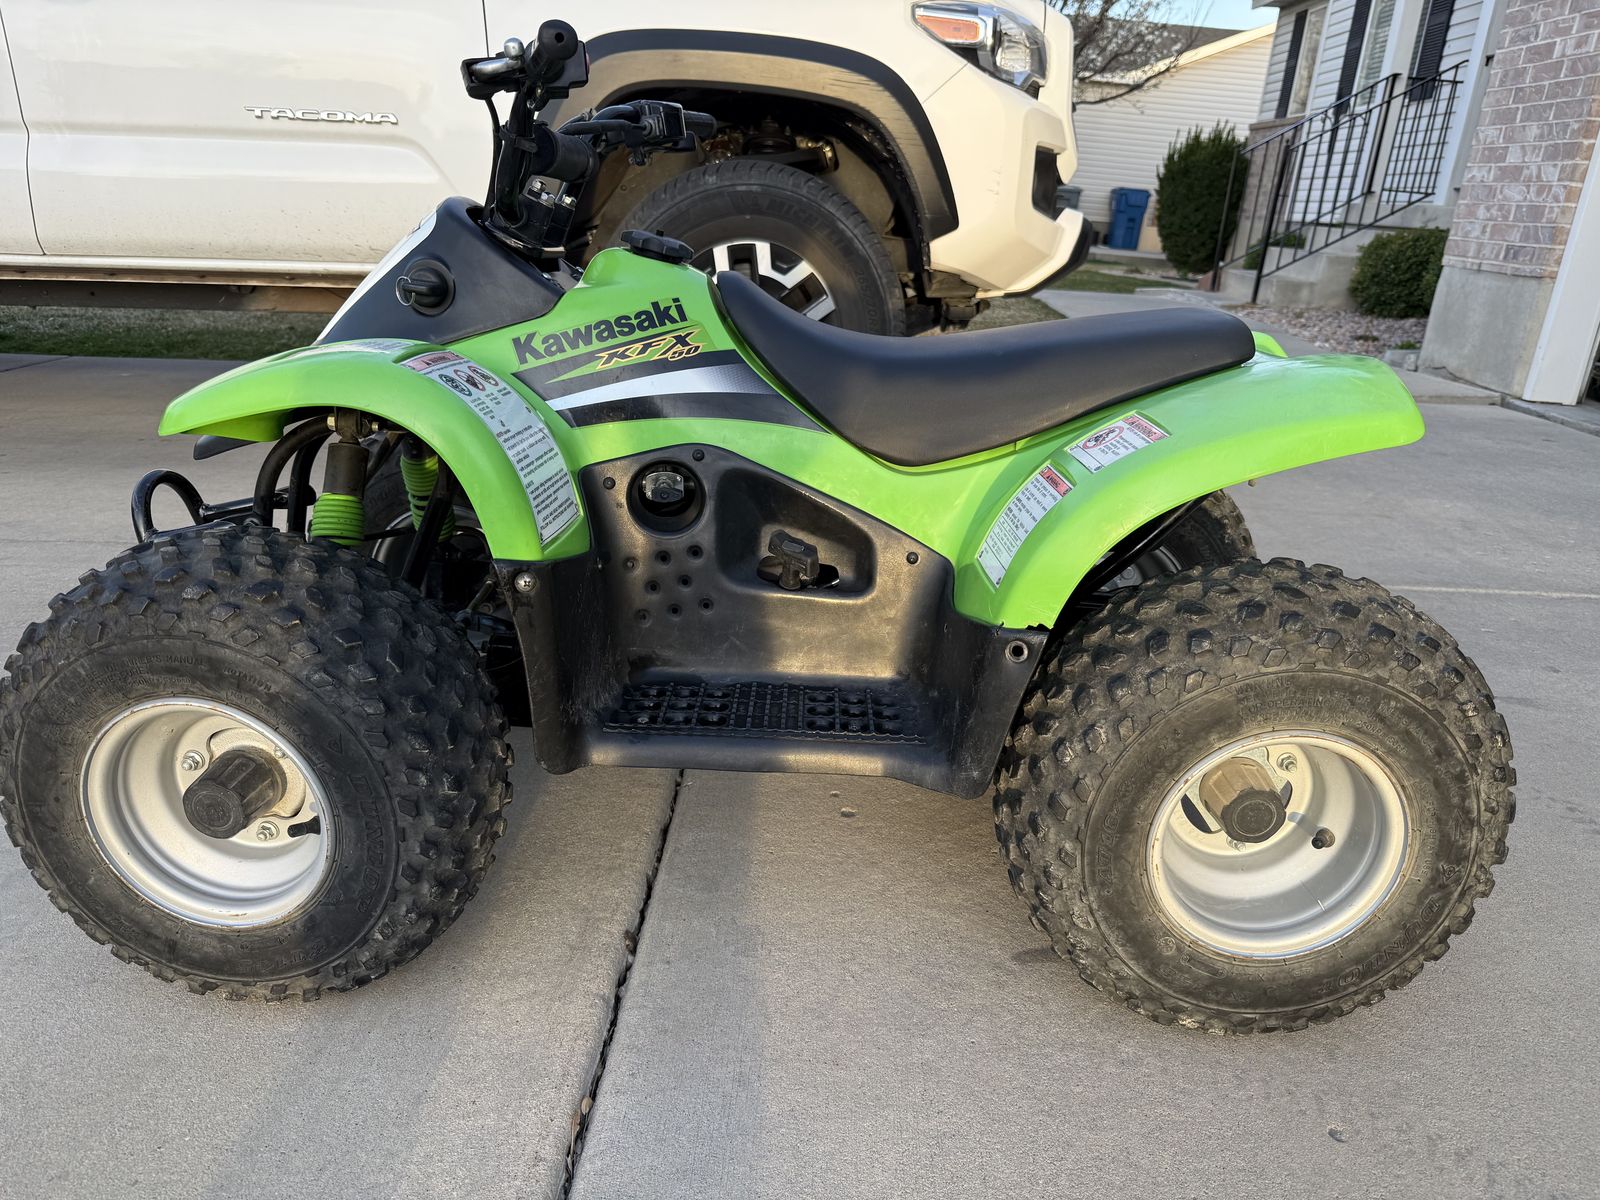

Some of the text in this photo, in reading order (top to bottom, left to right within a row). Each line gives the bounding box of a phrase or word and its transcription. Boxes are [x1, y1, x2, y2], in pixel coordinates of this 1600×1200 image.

[244, 106, 399, 125] TACOMA
[511, 297, 689, 366] Kawasaki
[595, 329, 702, 370] KFX 50
